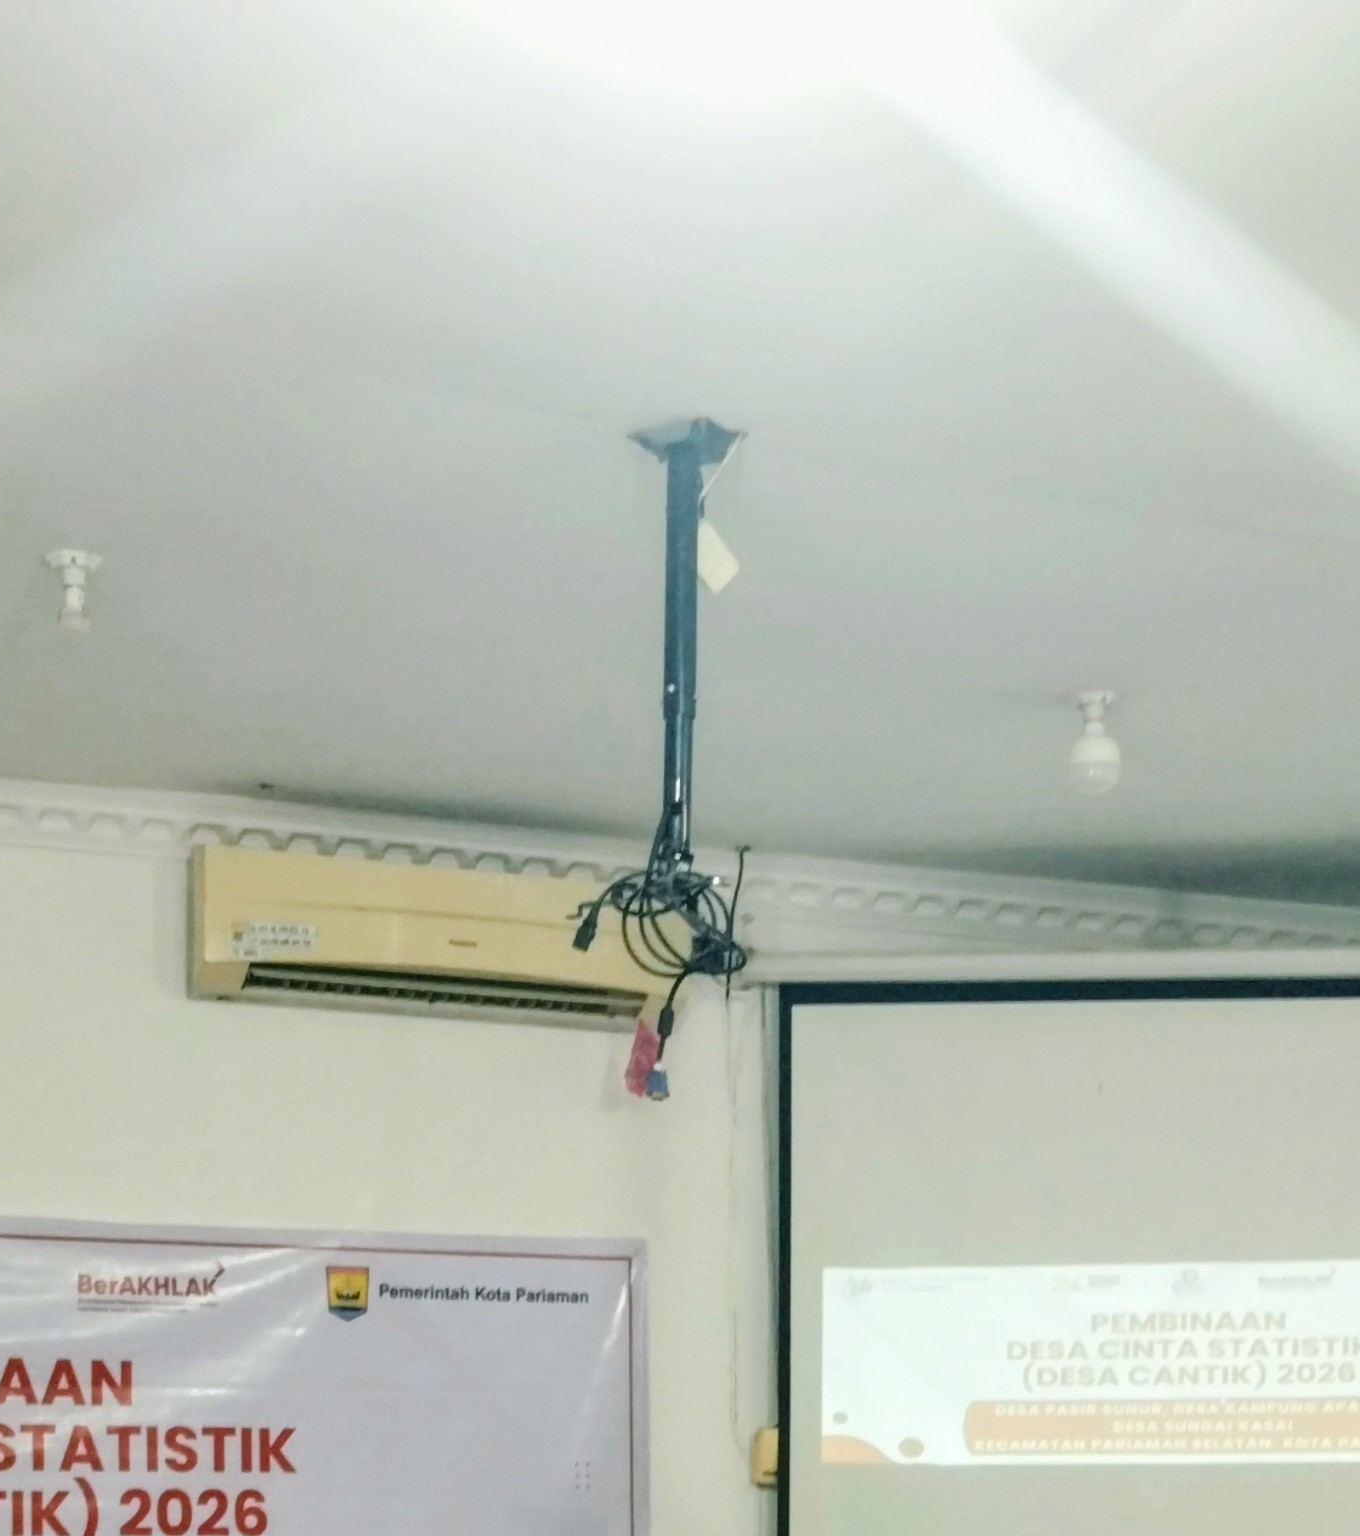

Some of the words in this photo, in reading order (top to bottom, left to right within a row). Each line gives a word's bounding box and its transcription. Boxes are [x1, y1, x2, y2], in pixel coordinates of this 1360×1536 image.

[77, 1264, 226, 1298] BerAKHLAK
[379, 1283, 470, 1300] Pemerintah
[474, 1286, 511, 1302] Kota
[515, 1287, 590, 1304] Pariaman
[1090, 1311, 1287, 1333] PEMBINAAN
[1006, 1340, 1089, 1361] DESA
[1096, 1337, 1198, 1361] CINTA
[1021, 1362, 1120, 1393] (DESA
[1128, 1359, 1268, 1391] CANTIK)
[1276, 1362, 1357, 1386] 2026
